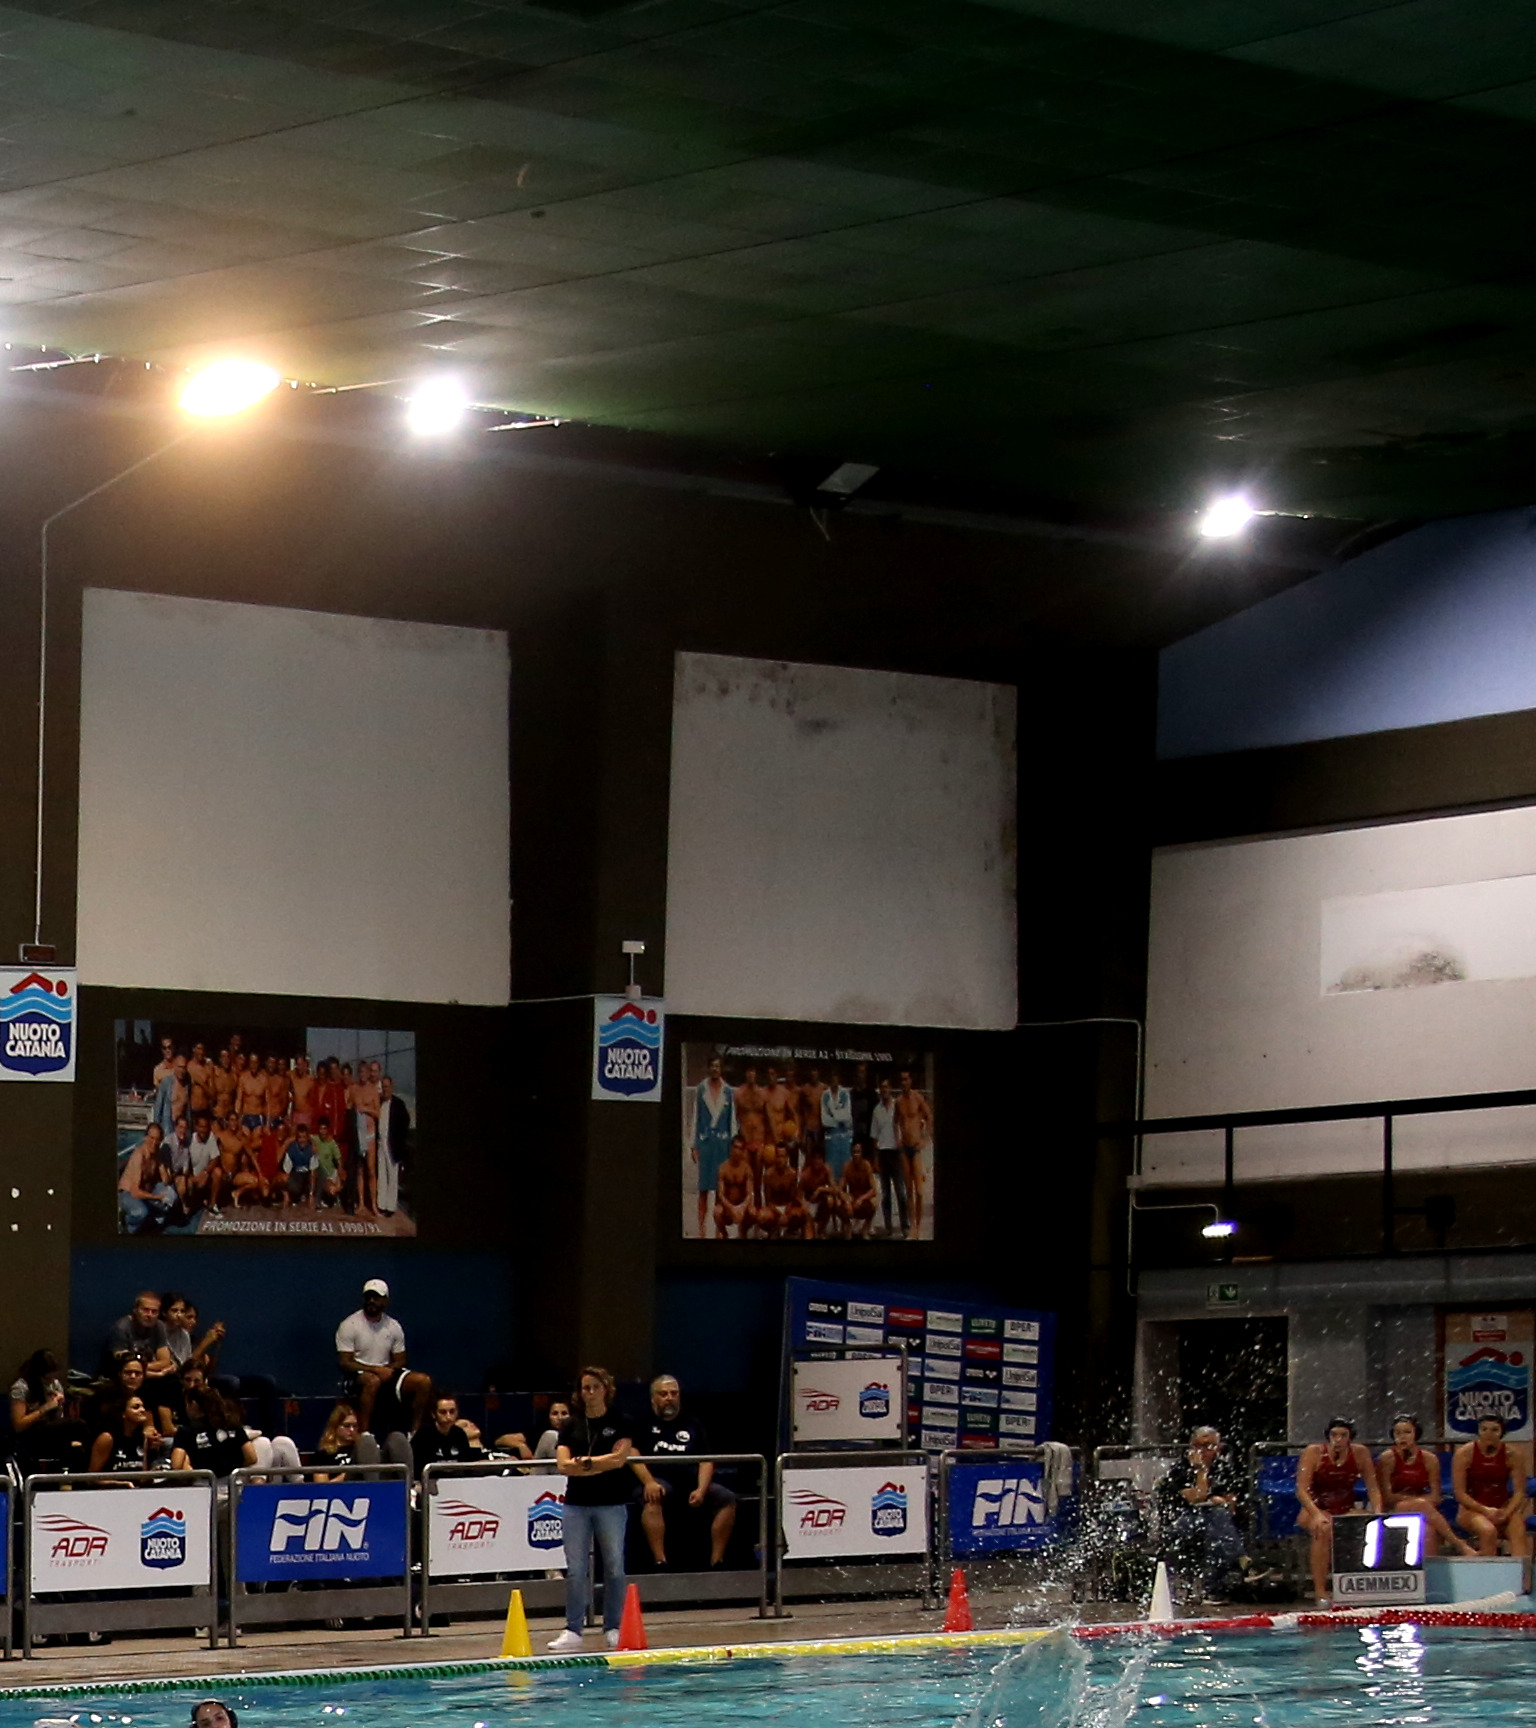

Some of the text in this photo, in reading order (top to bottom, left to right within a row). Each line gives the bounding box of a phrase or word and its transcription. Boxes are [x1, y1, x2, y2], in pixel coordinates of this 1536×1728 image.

[8, 1022, 61, 1041] NUOTO
[5, 1040, 66, 1058] CATANIA
[607, 1047, 650, 1065] NUOTO
[604, 1063, 654, 1080] CATANIA
[202, 1221, 272, 1232] PROMOZIONE
[274, 1221, 287, 1232] IN
[289, 1221, 319, 1233] SERIE
[321, 1222, 333, 1233] A1
[1458, 1390, 1515, 1406] NUOTO
[972, 1478, 1046, 1526] FIN
[270, 1497, 370, 1552] FIN
[800, 1509, 847, 1529] ADR
[449, 1520, 499, 1541] ADR
[51, 1536, 109, 1558] ADR
[147, 1537, 180, 1549] NUOTO
[1362, 1514, 1425, 1568] 17
[144, 1548, 182, 1560] CATANIA
[1345, 1576, 1411, 1592] AEMMEX
